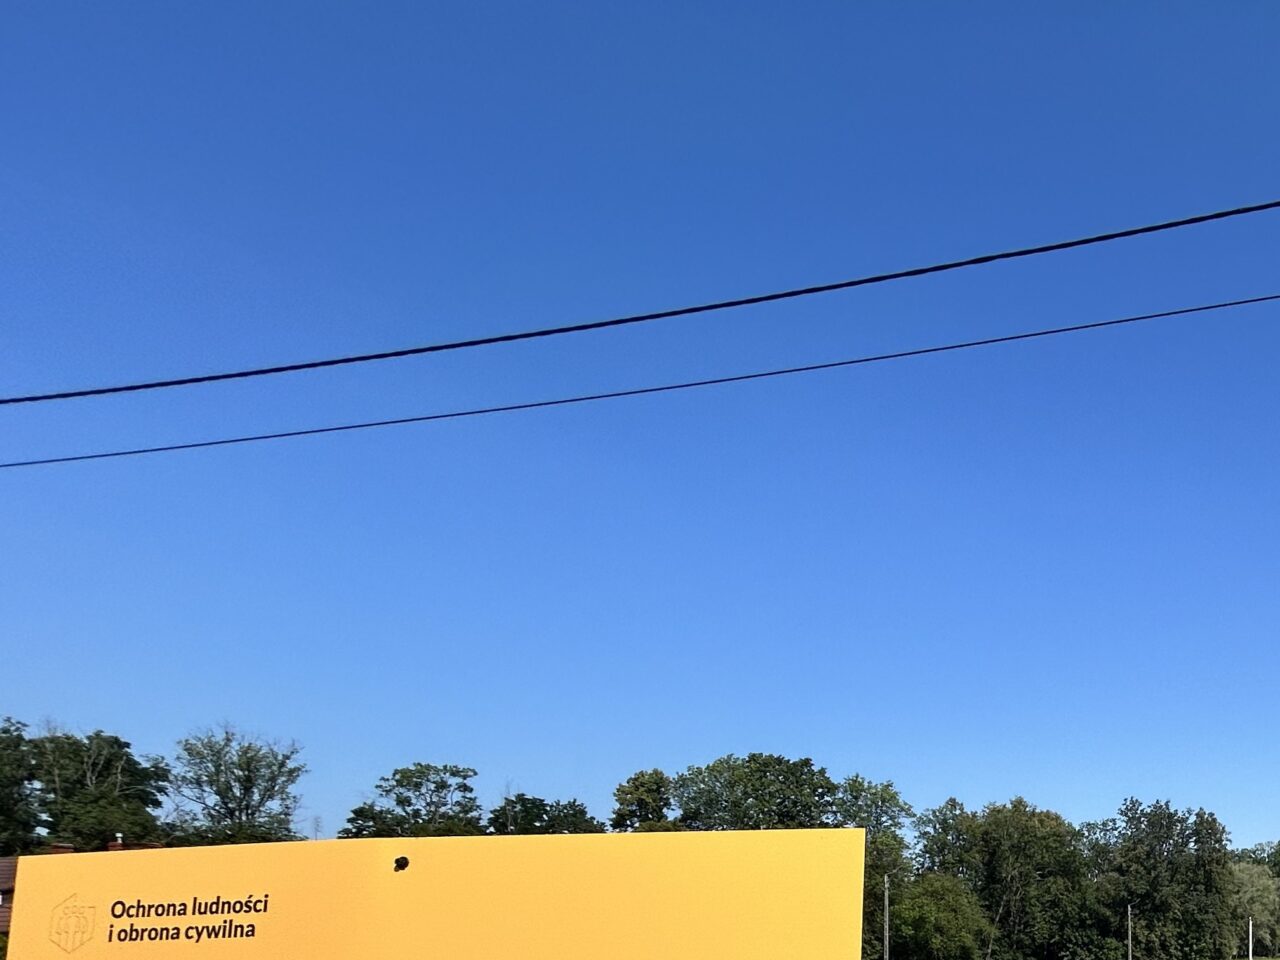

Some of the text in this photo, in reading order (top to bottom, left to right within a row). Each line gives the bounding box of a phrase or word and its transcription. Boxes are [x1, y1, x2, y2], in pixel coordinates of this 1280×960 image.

[110, 893, 269, 919] Ochrona ludności
[108, 918, 256, 944] i obrona cywilna
